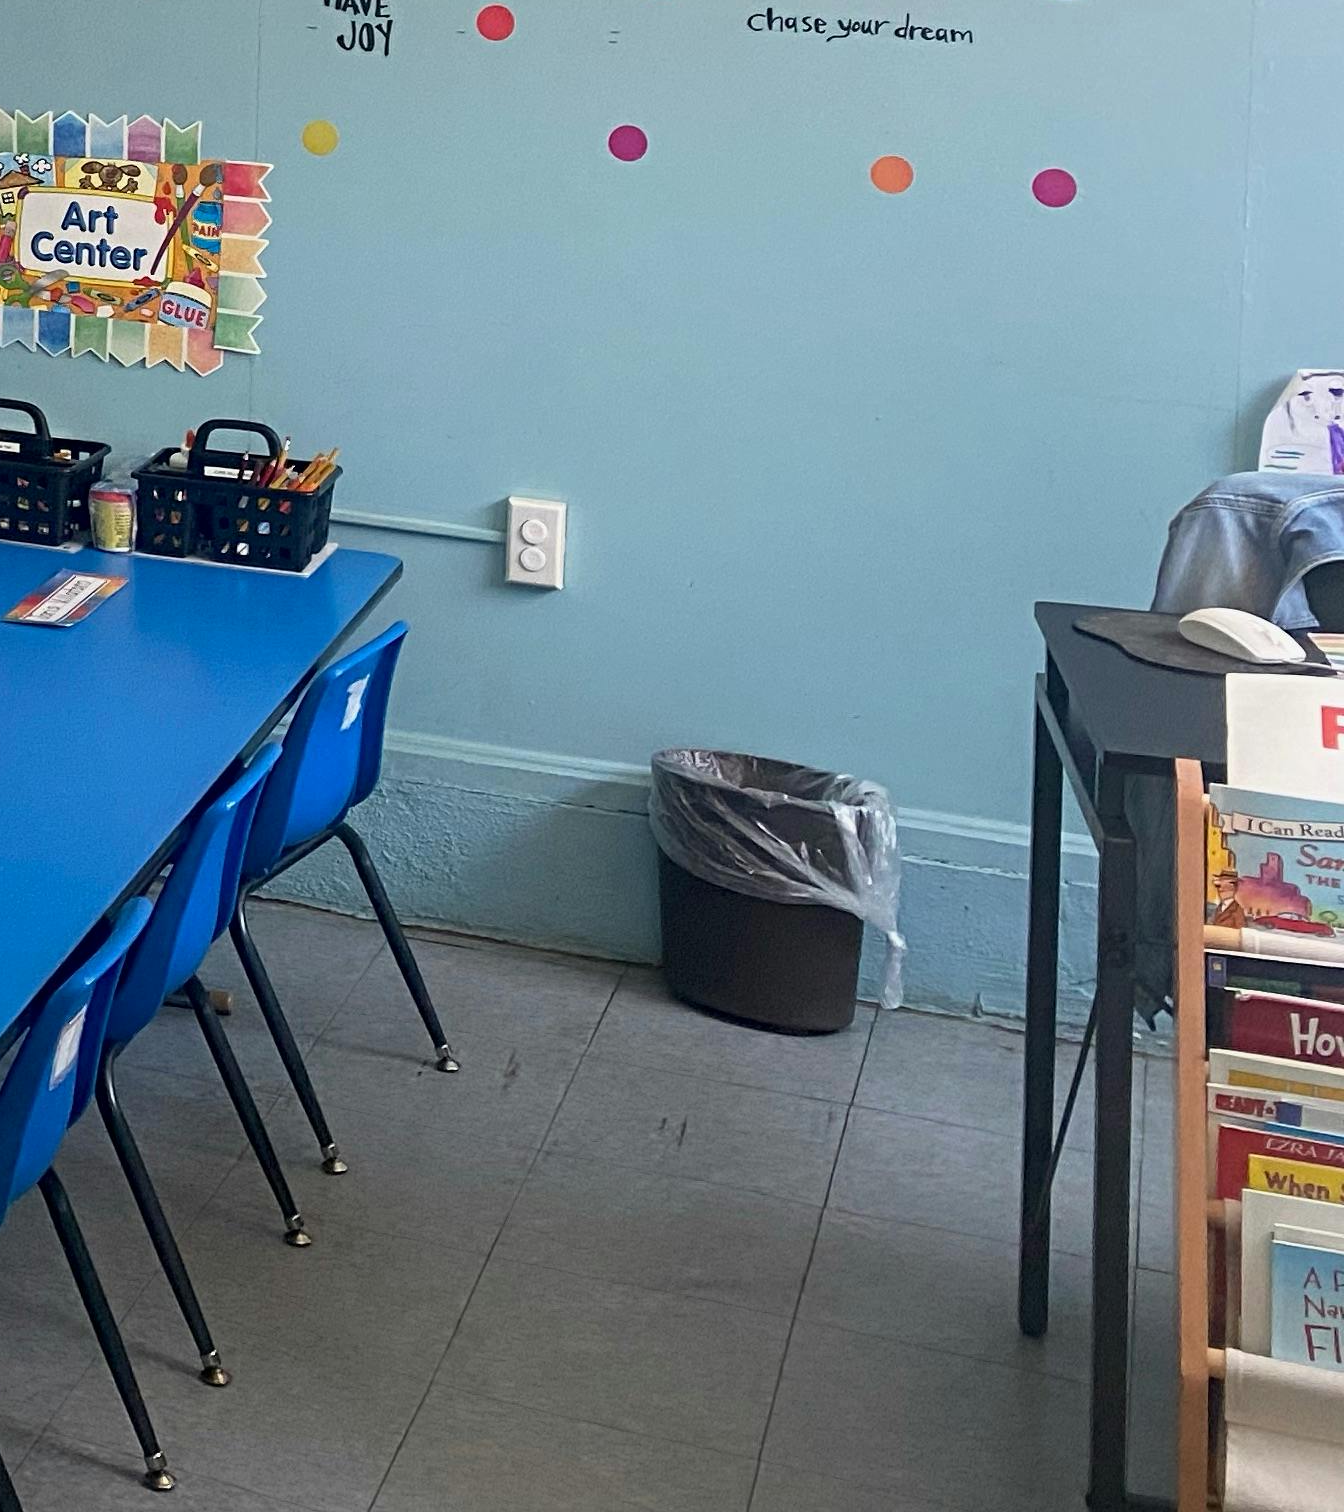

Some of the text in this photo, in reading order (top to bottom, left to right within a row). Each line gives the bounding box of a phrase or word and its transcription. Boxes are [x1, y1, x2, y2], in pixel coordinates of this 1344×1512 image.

[336, 19, 394, 57] JOY
[746, 7, 974, 43] chase your dream
[62, 201, 119, 236] Art
[30, 231, 148, 271] Center
[162, 299, 207, 327] GLUE
[1247, 818, 1344, 839] I Can Read
[1305, 873, 1341, 889] THE
[1266, 1136, 1317, 1158] EZRA
[1264, 1170, 1330, 1200] When
[1304, 1266, 1322, 1289] A
